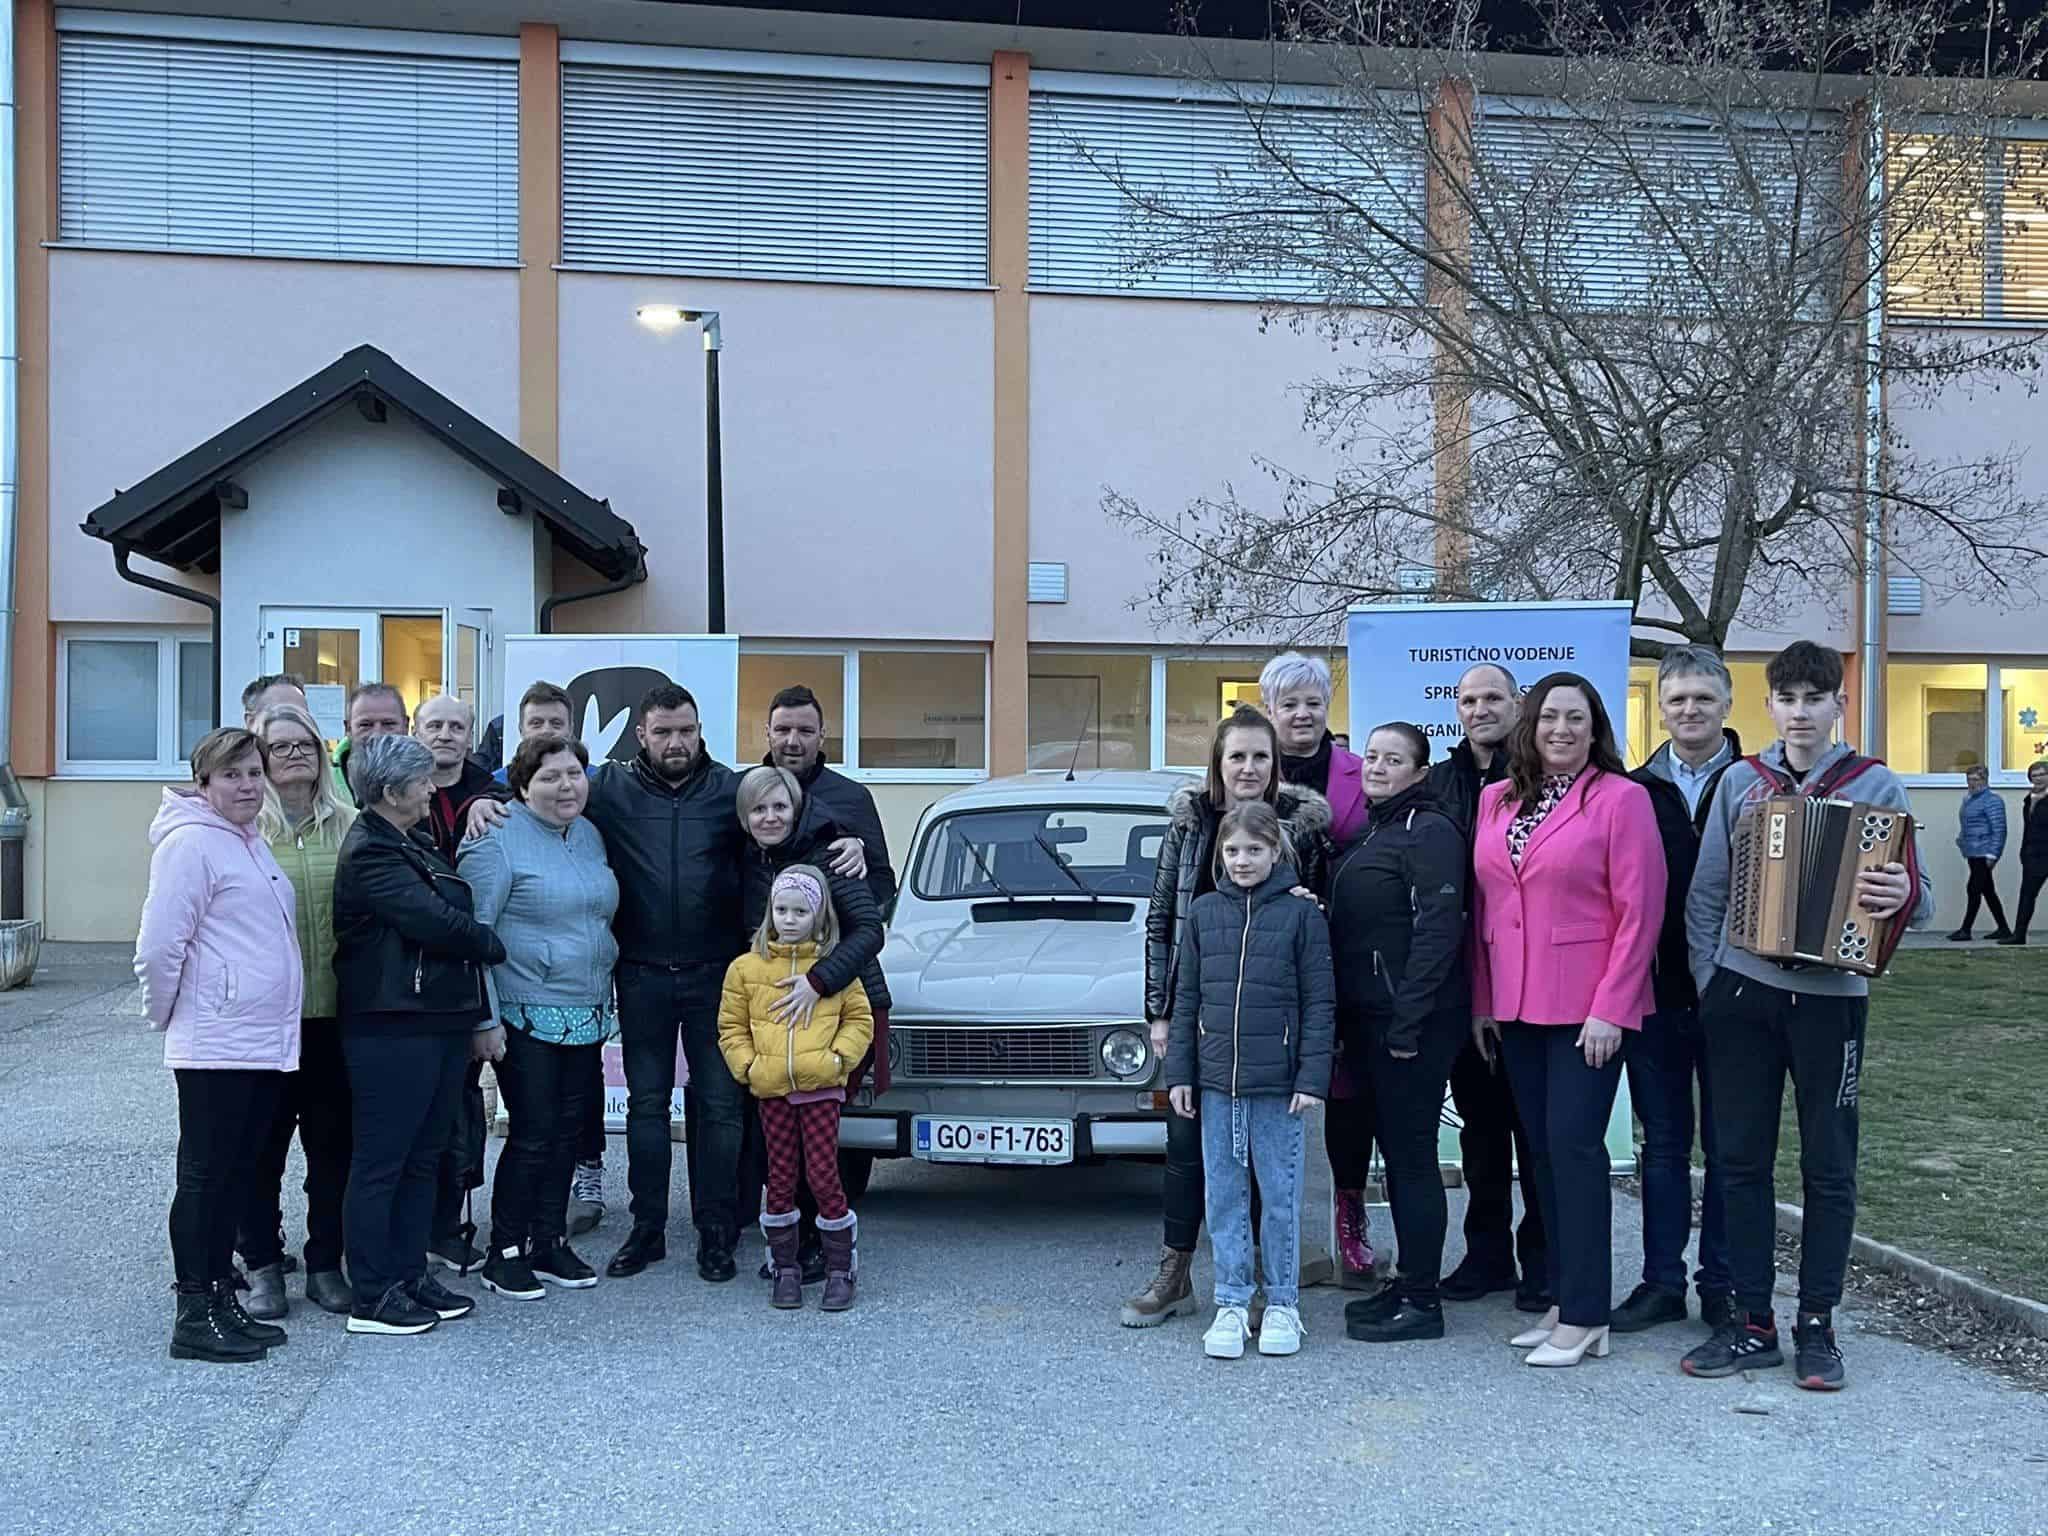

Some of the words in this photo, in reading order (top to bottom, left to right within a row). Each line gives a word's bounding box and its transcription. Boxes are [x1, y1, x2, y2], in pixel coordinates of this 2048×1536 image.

[1409, 646, 1500, 662] TURISTIČNO
[1504, 646, 1575, 661] VODENJE
[1424, 686, 1459, 700] SPRE
[937, 1124, 972, 1149] GO
[990, 1126, 1064, 1152] F1-763
